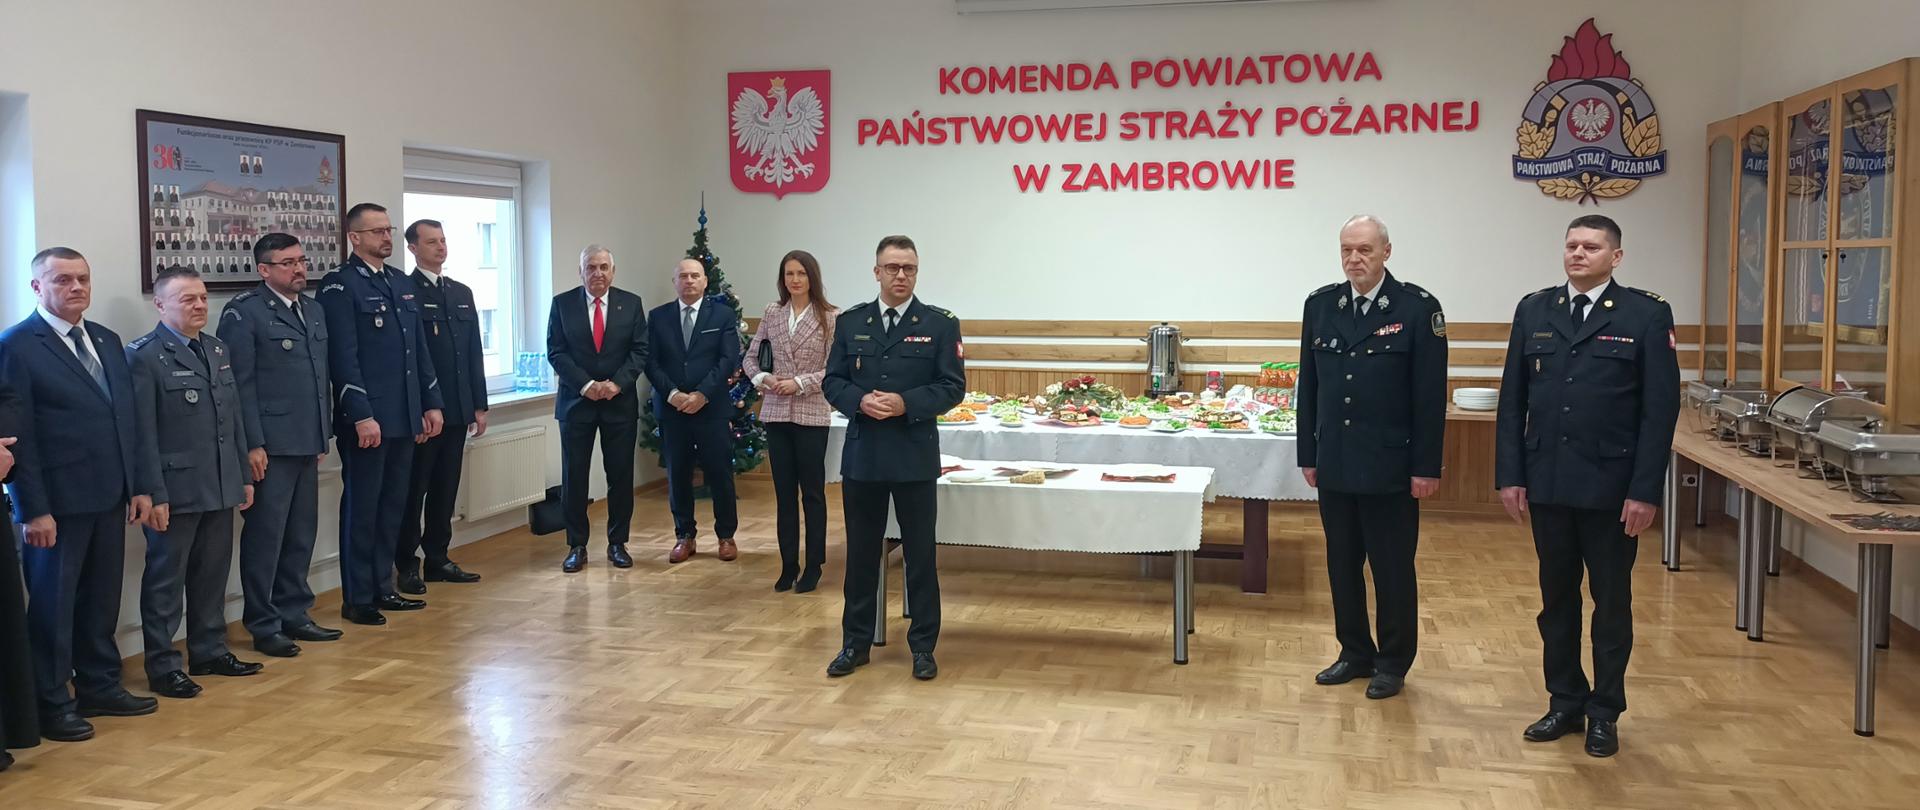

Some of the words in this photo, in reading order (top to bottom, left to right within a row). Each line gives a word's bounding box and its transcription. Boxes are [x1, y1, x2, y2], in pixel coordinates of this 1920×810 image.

[939, 62, 1119, 95] KOMENDA
[1131, 51, 1383, 90] POWIATOWA
[857, 109, 1108, 146] PAŃSTWOWEJ
[1119, 101, 1264, 142] STRAŻY
[1275, 97, 1480, 137] POŻARNEJ
[1013, 164, 1051, 192] W
[1061, 159, 1296, 192] ZAMBROWIE
[1517, 158, 1574, 176] PAŃSTWOWA
[1577, 152, 1605, 167] STRAŻ
[1610, 158, 1661, 175] POŻARNA
